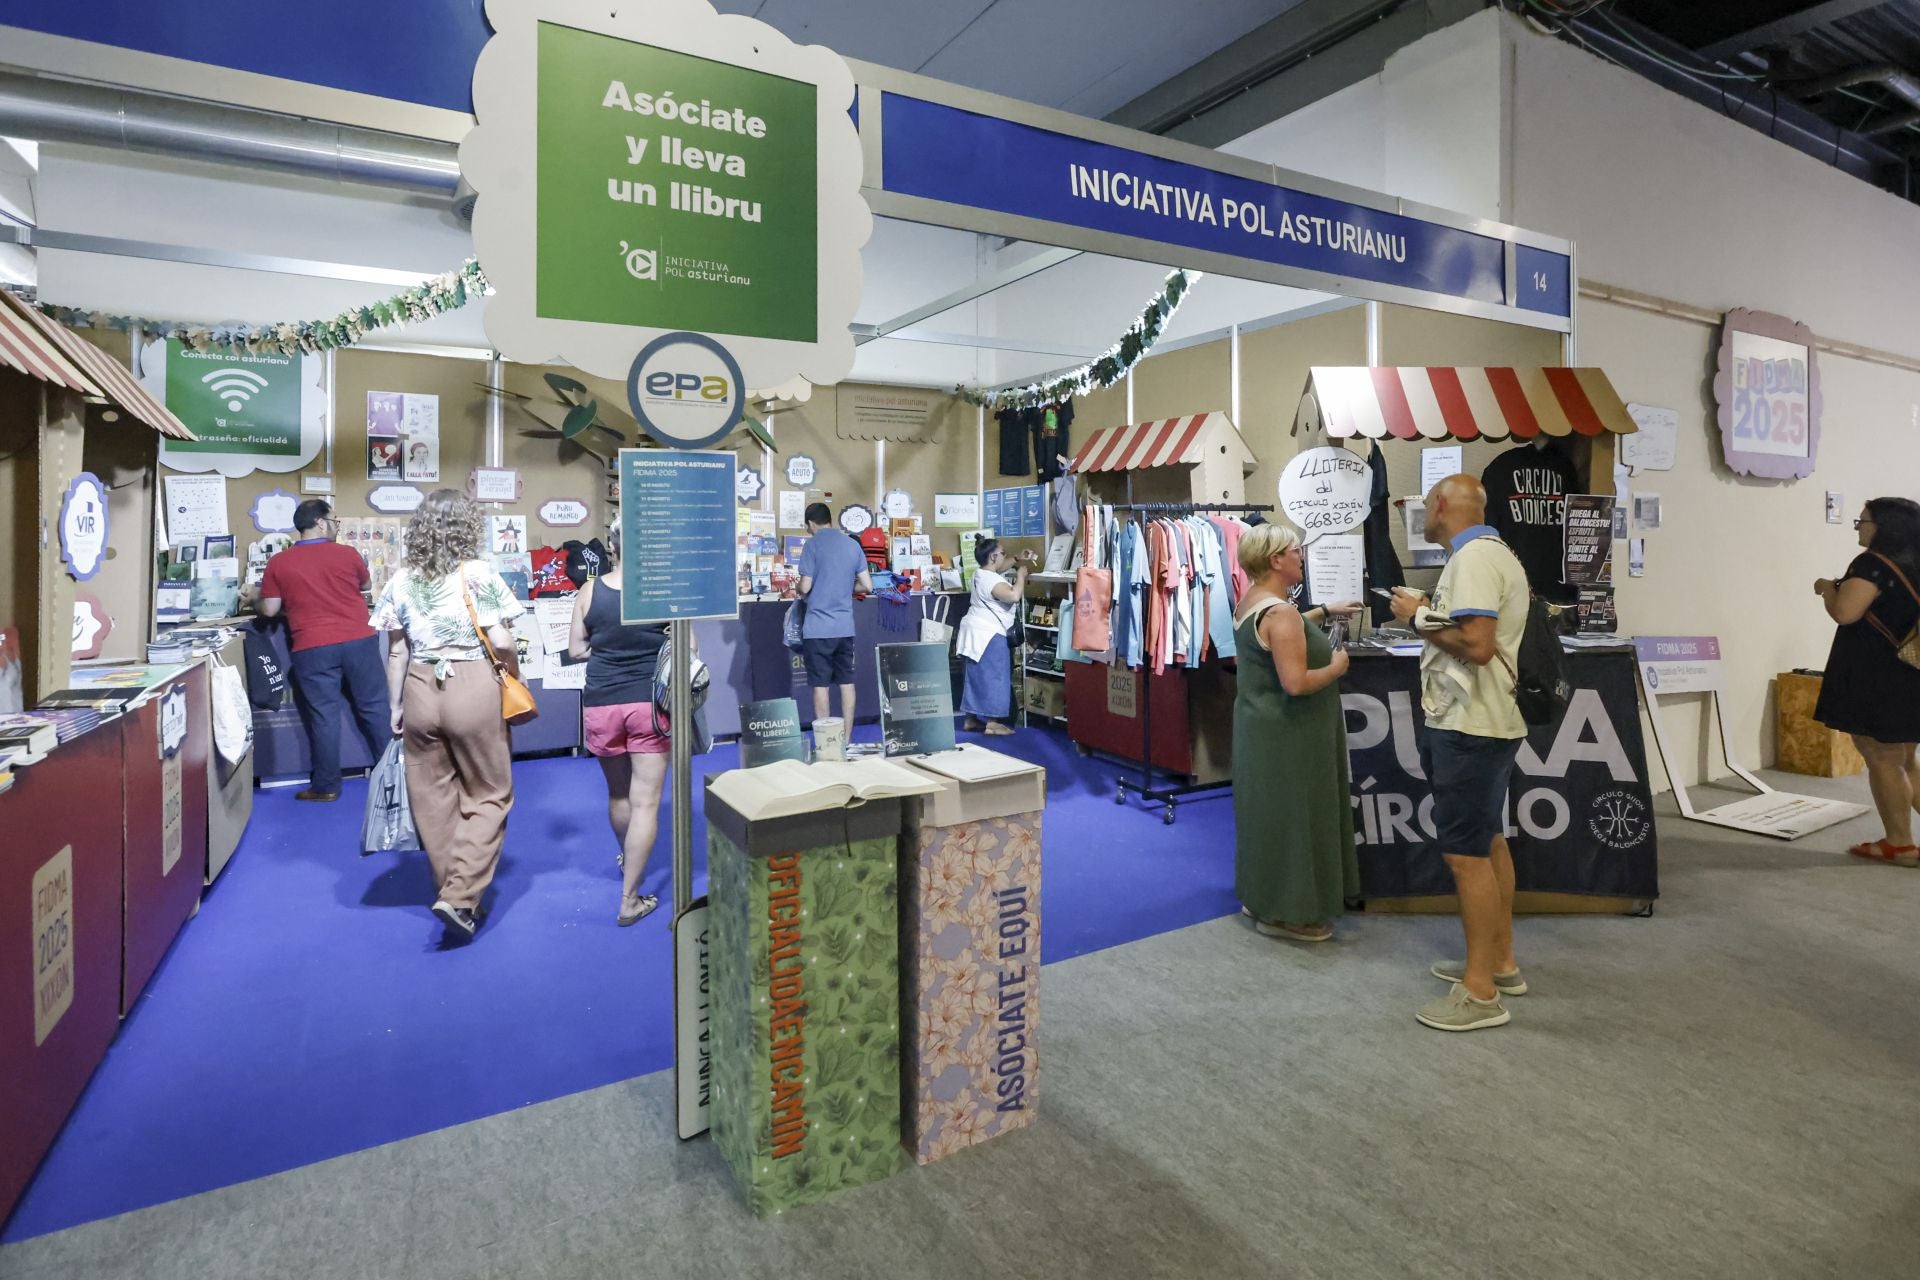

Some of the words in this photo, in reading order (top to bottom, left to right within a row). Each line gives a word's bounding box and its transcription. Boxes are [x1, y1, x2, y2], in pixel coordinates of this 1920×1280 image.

[602, 80, 767, 138] Asóciate
[625, 135, 649, 165] y
[661, 135, 746, 177] lleva
[607, 178, 657, 206] un
[670, 181, 761, 223] llibru
[1070, 164, 1217, 226] INICIATIVA
[1222, 198, 1274, 237] POL
[1279, 211, 1406, 263] ASTURIANU
[665, 256, 729, 272] INICIATIVA
[665, 267, 685, 277] POL
[687, 269, 751, 285] asturianu
[1533, 272, 1547, 292] 14
[180, 350, 222, 360] Conecta
[241, 355, 289, 365] asturianu
[646, 372, 728, 399] epa
[1734, 392, 1805, 445] 2025
[633, 460, 674, 468] INICIATIVA
[688, 461, 726, 469] ASTURIANU
[1300, 456, 1365, 478] LLOTERIA
[1316, 480, 1332, 493] del
[1289, 498, 1328, 510] CIRCULO
[76, 516, 95, 534] VIR
[1656, 643, 1680, 655] FIDMA
[1681, 643, 1698, 655] 2025
[1110, 674, 1133, 693] 2025
[1340, 688, 1639, 784] PUA
[38, 868, 68, 922] FIDMA
[992, 886, 1030, 959] EQUÍ
[39, 910, 68, 975] 2025
[990, 965, 1026, 1113] ASÓCIATE
